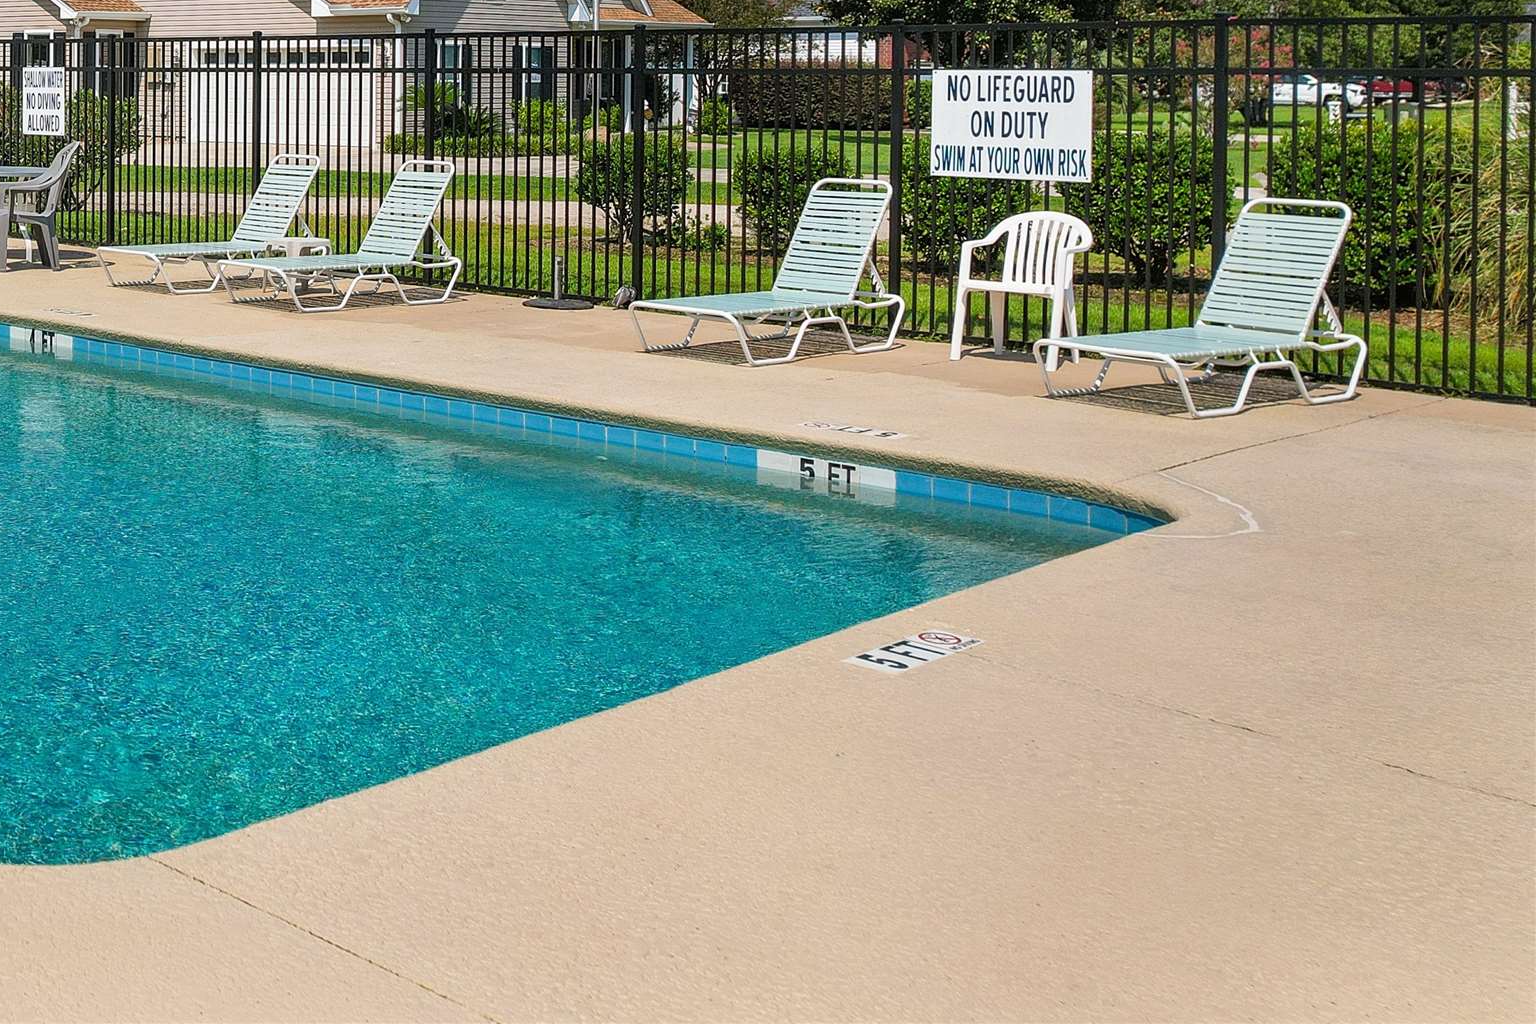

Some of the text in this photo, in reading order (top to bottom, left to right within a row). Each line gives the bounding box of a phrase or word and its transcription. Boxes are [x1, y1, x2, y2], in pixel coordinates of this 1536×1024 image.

[24, 71, 63, 88] SHALLOW WATER
[947, 74, 1075, 103] NO LIFEGUARD
[26, 93, 61, 110] NO DIVING
[27, 114, 60, 132] ALLOWED
[971, 111, 1048, 139] ON DUTY
[934, 144, 1086, 177] SWIM AT YOUR OWN RISK
[42, 330, 55, 345] FT
[800, 457, 856, 484] 5 FT
[855, 640, 946, 669] 5 FT
